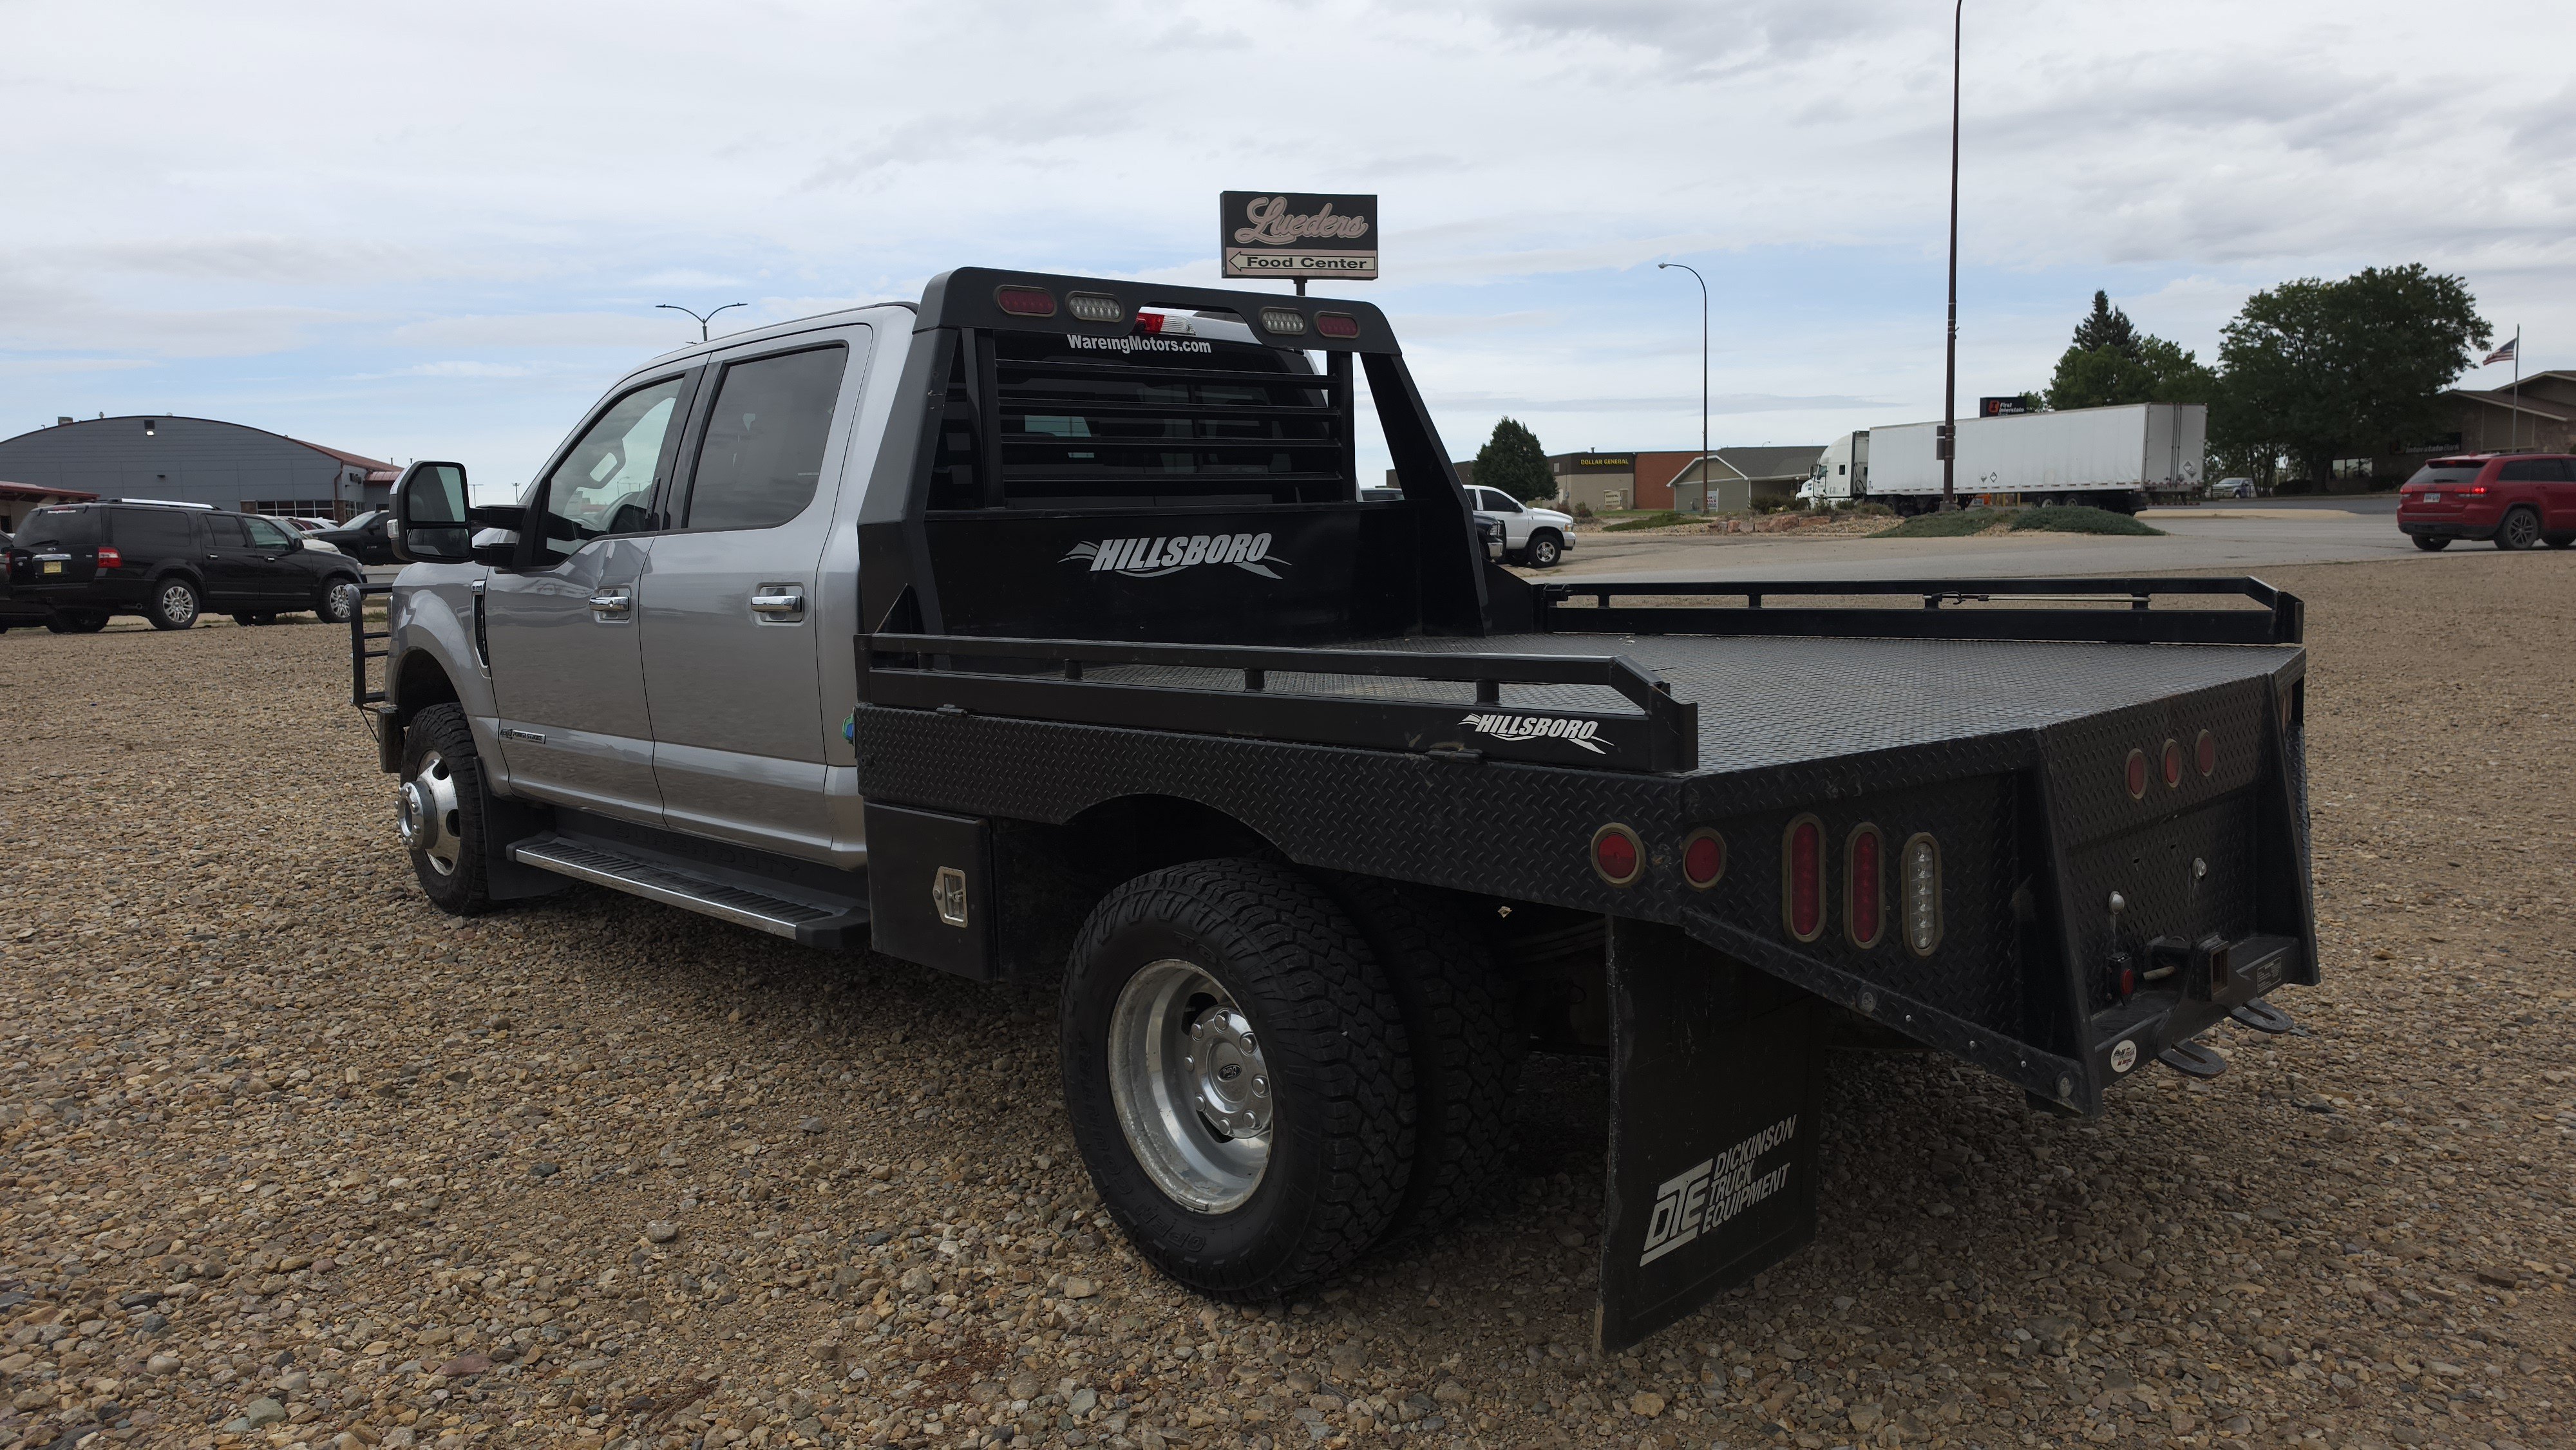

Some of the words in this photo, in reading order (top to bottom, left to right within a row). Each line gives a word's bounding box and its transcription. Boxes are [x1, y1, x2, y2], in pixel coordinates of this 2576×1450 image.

[1235, 196, 1368, 245] Lueders
[1247, 256, 1293, 268] Food
[1300, 257, 1367, 269] Center
[1066, 334, 1212, 354] WareingMotors.com
[1090, 533, 1273, 572] HILLSBORO
[1475, 714, 1598, 740] HILLSBORO
[1222, 1066, 1237, 1078] Ford
[1714, 1114, 1797, 1178] DICKINSON
[1701, 1162, 1790, 1234] EQUIPMENT
[1709, 1160, 1754, 1207] TRUCK
[1134, 1203, 1206, 1252] OPEN
